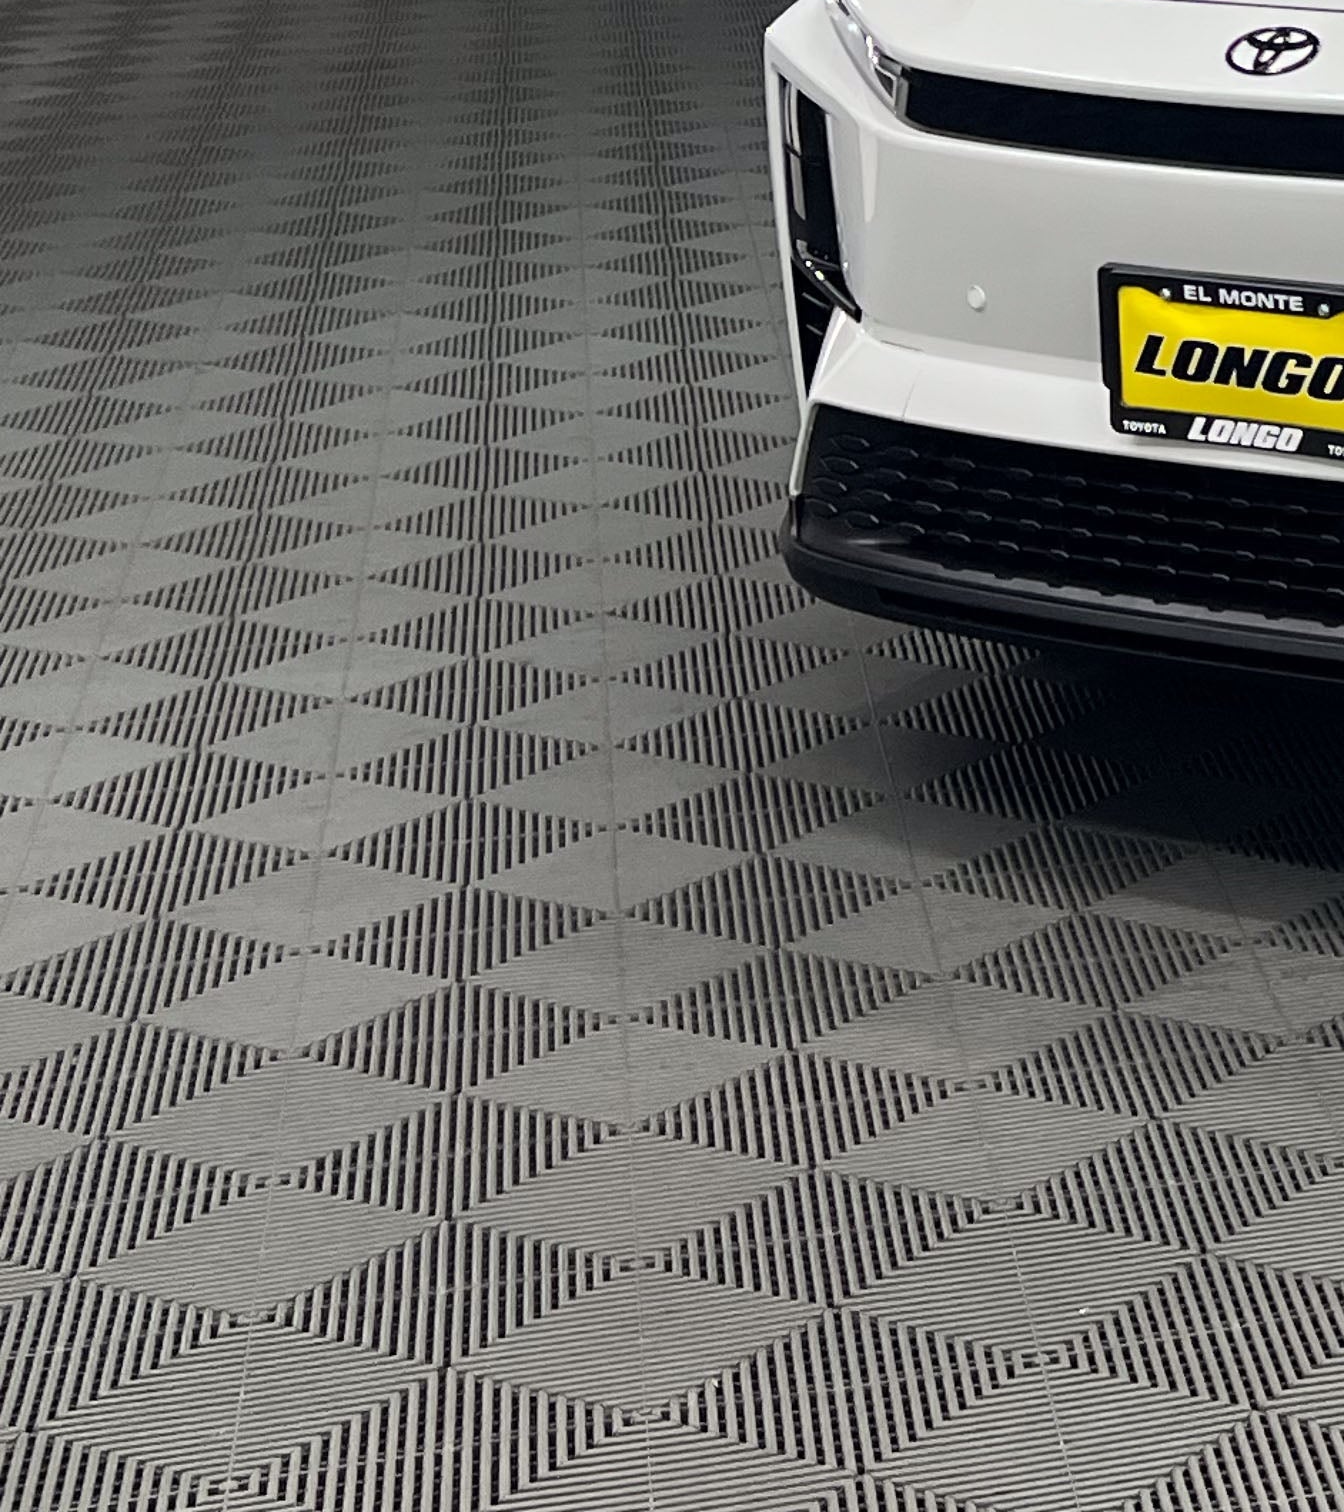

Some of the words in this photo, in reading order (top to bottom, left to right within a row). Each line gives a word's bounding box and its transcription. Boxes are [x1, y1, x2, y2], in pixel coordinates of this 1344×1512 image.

[1183, 285, 1212, 302] EL
[1219, 289, 1304, 312] MONTE
[1122, 420, 1167, 435] TOYOTA
[1187, 416, 1304, 452] LONGO
